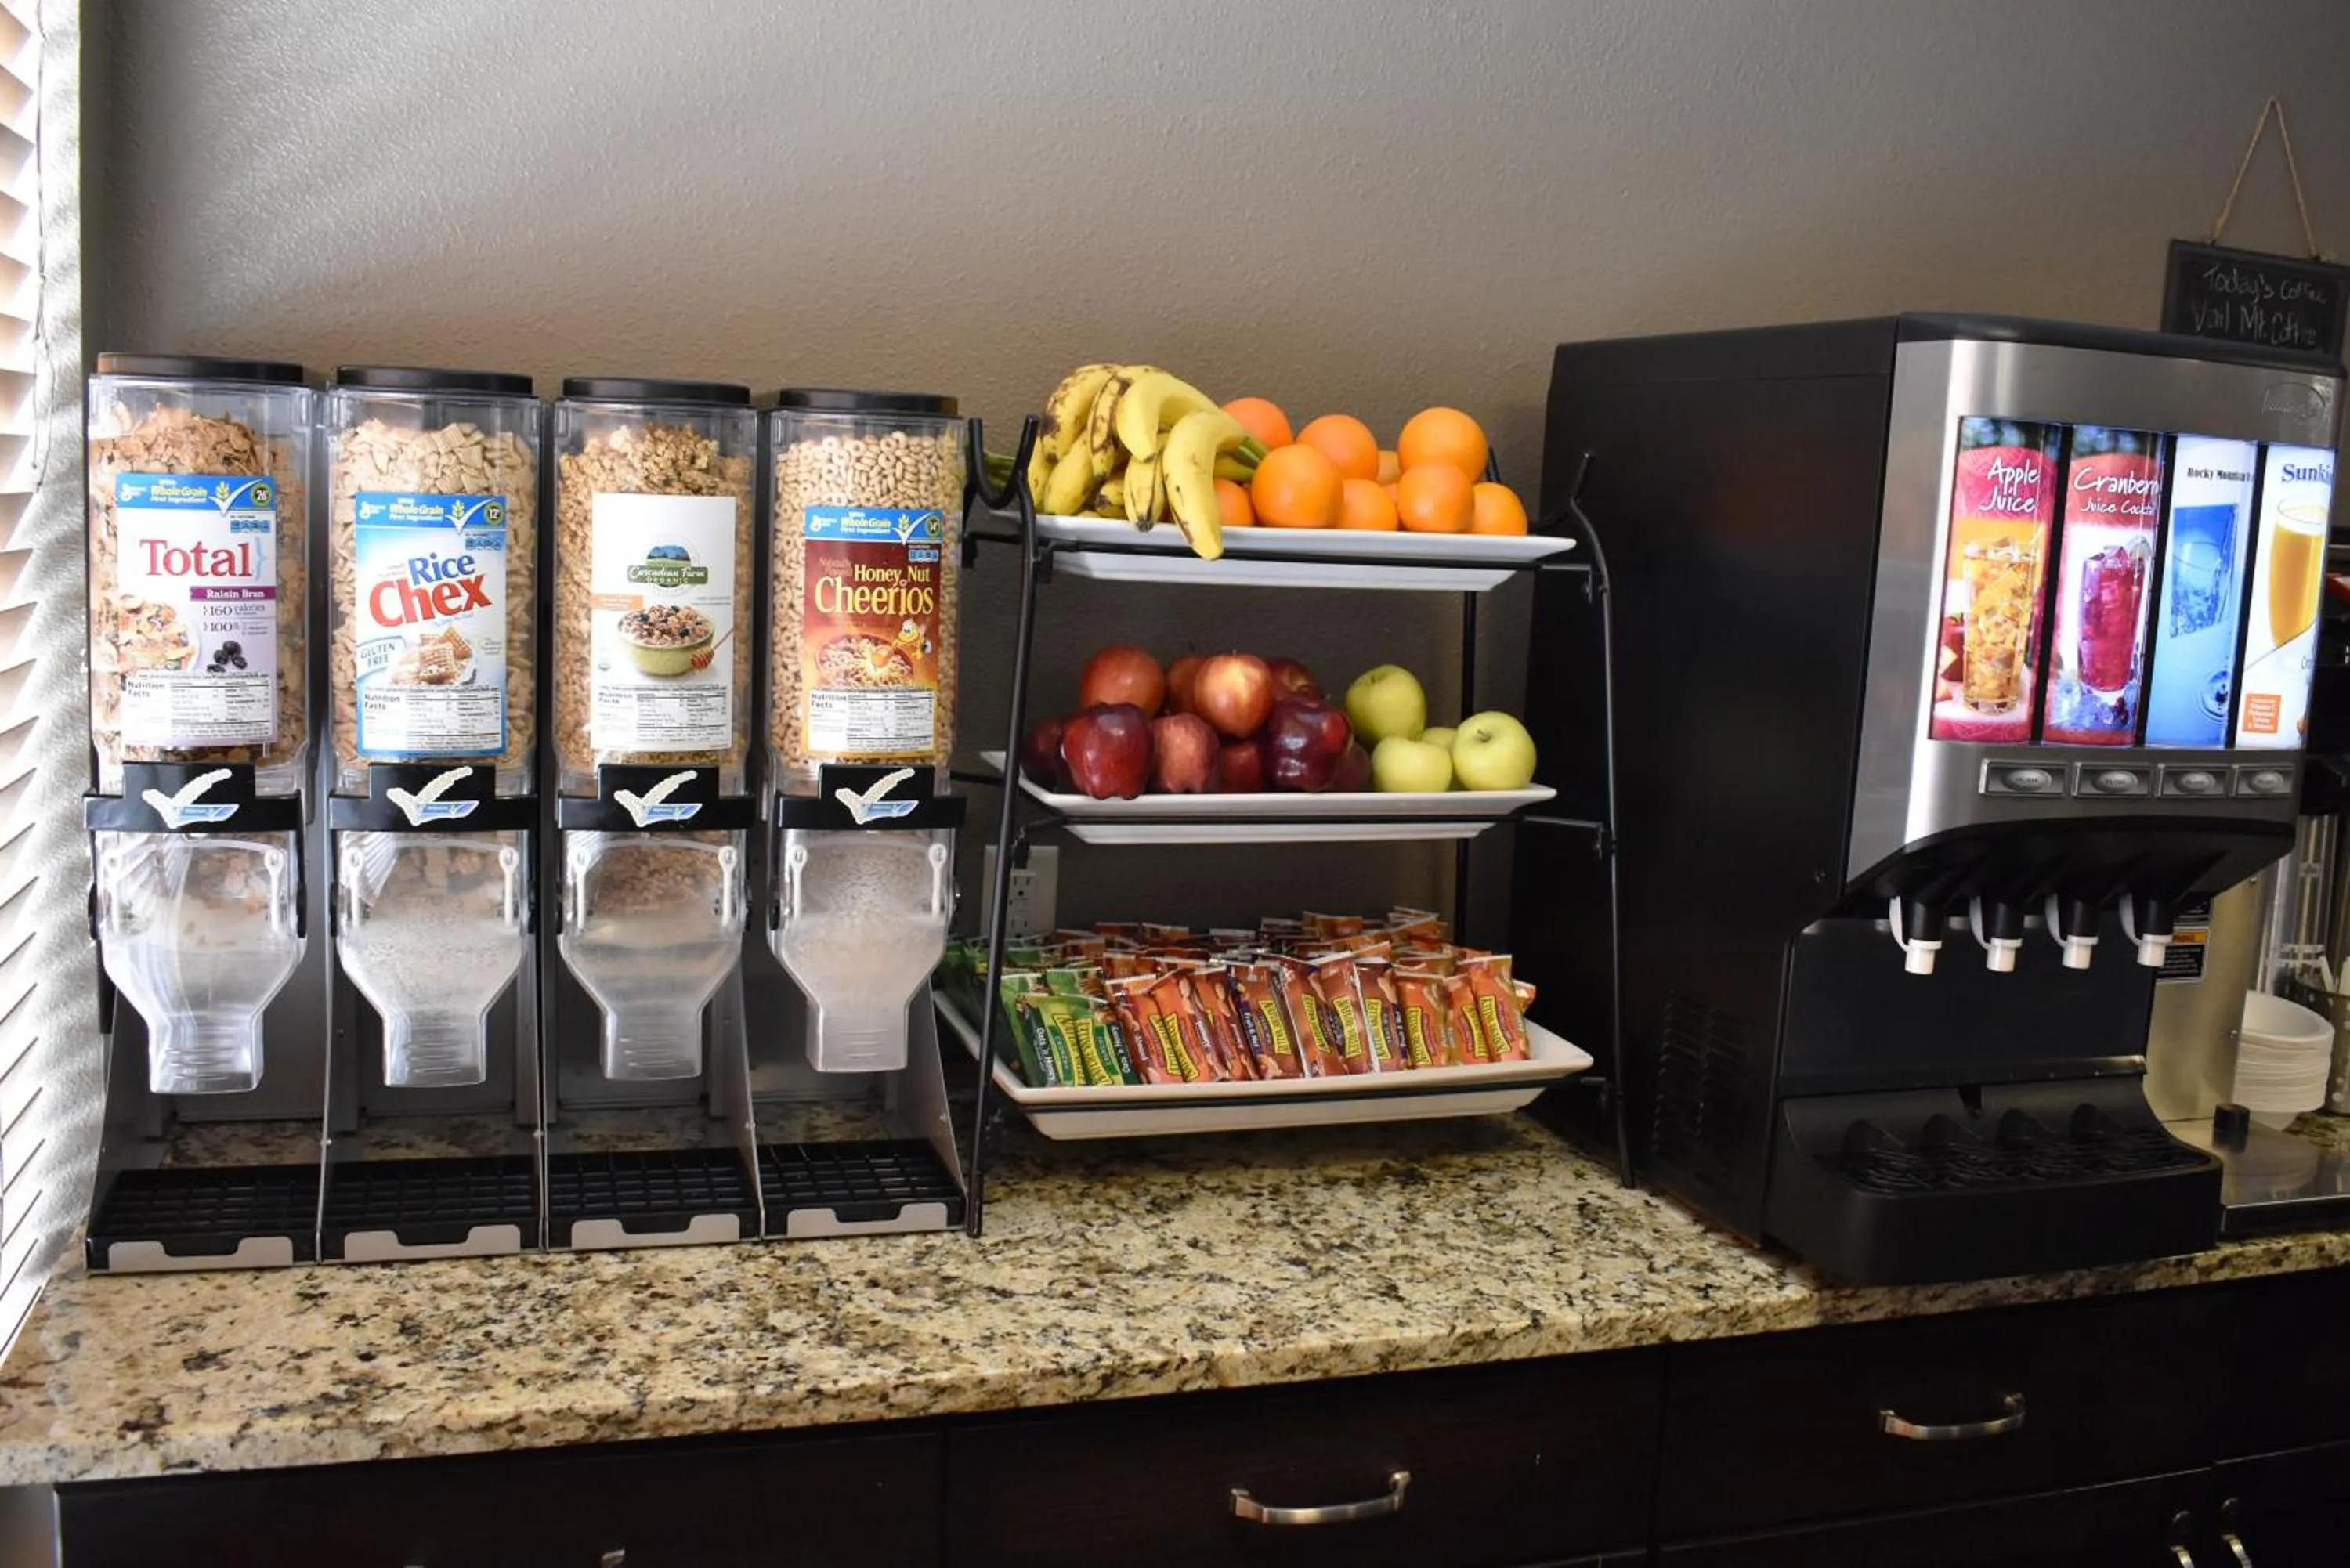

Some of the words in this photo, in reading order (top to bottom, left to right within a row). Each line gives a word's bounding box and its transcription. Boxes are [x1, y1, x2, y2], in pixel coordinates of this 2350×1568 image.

[2202, 265, 2274, 303] Today's
[1987, 457, 2039, 495] Apple
[2187, 467, 2213, 480] Rocky
[2280, 463, 2334, 484] Sunki
[1979, 488, 2036, 512] Juice
[2080, 499, 2117, 513] Juice
[139, 538, 253, 577] Total
[408, 552, 475, 586] Rice
[628, 565, 679, 579] Cascadian
[680, 566, 705, 578] Farm
[854, 564, 902, 587] Honey
[907, 565, 931, 582] Nut
[206, 588, 239, 598] Raisin
[241, 588, 265, 598] Bran
[369, 573, 493, 627] Chex
[815, 576, 935, 616] Cheerios
[209, 605, 233, 616] 160
[360, 641, 396, 659] GLUTEN
[367, 655, 389, 667] FREE
[128, 681, 165, 690] Nutrition
